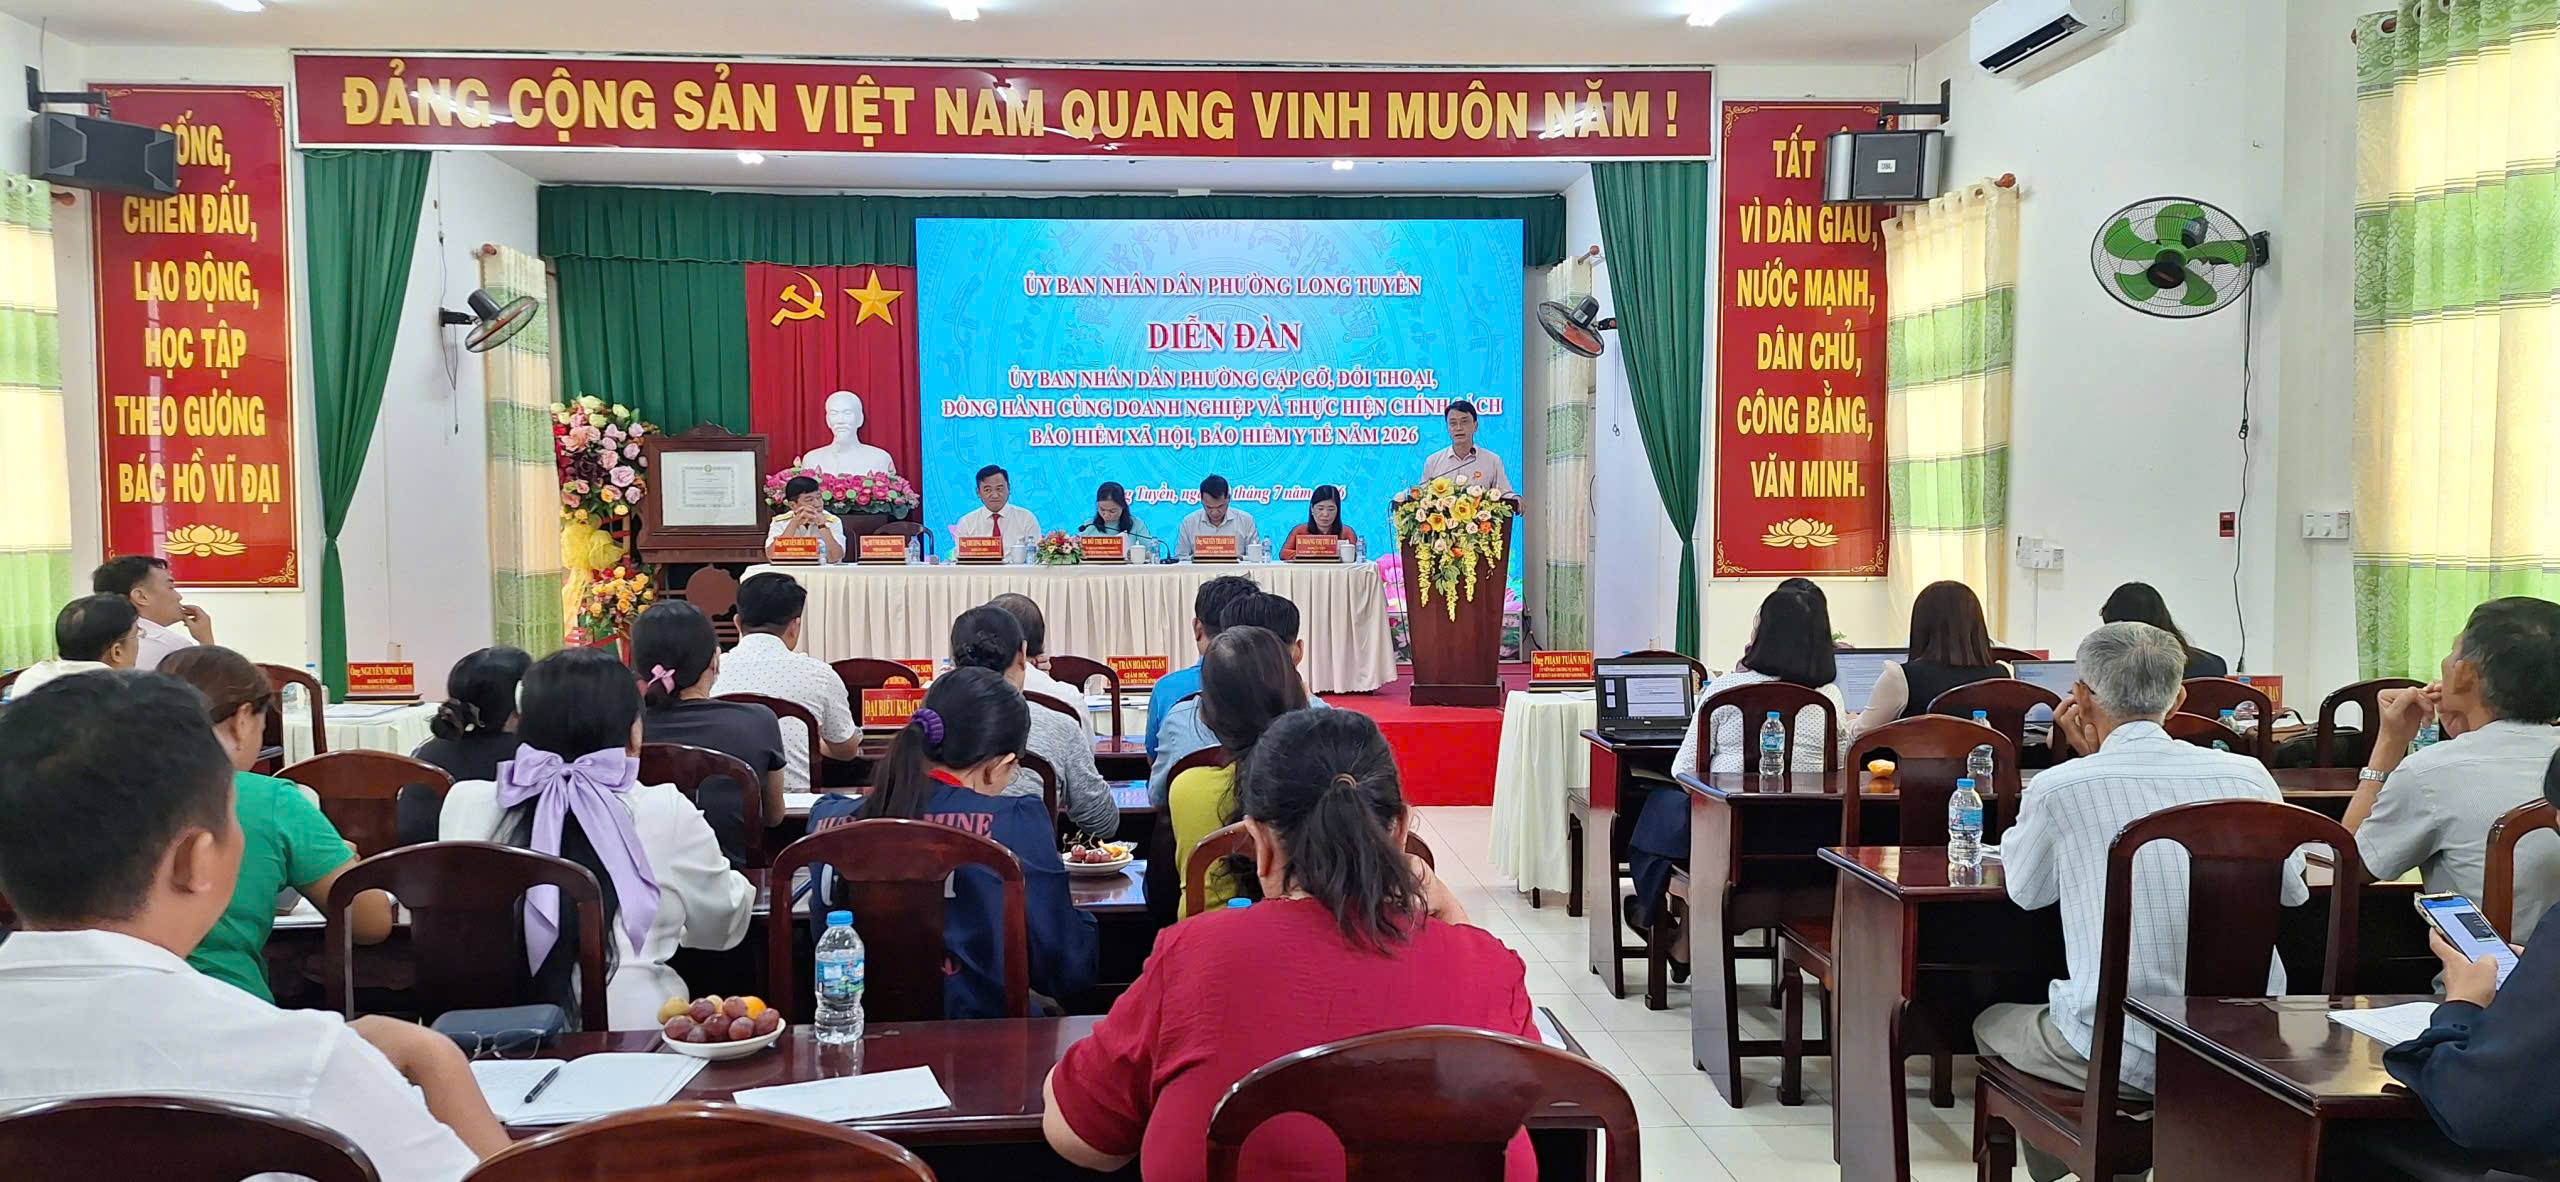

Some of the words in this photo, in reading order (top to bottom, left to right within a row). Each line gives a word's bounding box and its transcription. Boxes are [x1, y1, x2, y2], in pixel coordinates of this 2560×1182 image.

[341, 58, 491, 130] ĐẢNG
[508, 67, 656, 142] CỘNG
[673, 63, 777, 132] SẢN
[795, 74, 916, 147] VIỆT
[934, 88, 1044, 138] NAM
[1060, 89, 1234, 142] QUANG
[1251, 91, 1370, 139] VINH
[1387, 80, 1528, 139] MUÔN
[1543, 79, 1650, 138] NĂM
[160, 109, 231, 174] ỐNG,
[1772, 124, 1816, 179] TẤT
[201, 179, 258, 243] ĐẤU,
[1739, 196, 1761, 243] VÌ
[1766, 197, 1812, 243] DÂN
[134, 260, 180, 302] LAO
[185, 250, 260, 313] ĐỘNG,
[1025, 272, 1055, 294] ỦY
[1057, 277, 1096, 294] BAN
[1102, 272, 1156, 294] NHÂN
[1162, 271, 1202, 294] DÂN
[1208, 272, 1291, 294] PHƯỜNG
[1297, 277, 1351, 294] LONG
[1357, 271, 1421, 294] TUYỀN
[1737, 256, 1798, 308] NƯỚC
[1804, 269, 1876, 316] MẠNH,
[144, 327, 194, 380] HỌC
[200, 318, 248, 379] TẬP
[1148, 316, 1224, 350] DIỄN
[1234, 316, 1302, 350] ĐÀN
[1757, 324, 1804, 370] DÂN
[1809, 318, 1862, 378] CHỦ,
[1008, 366, 1036, 387] ỦY
[1040, 371, 1076, 387] BAN
[1081, 367, 1133, 387] NHÂN
[1137, 367, 1175, 387] DÂN
[1181, 366, 1258, 387] PHƯỜNG
[1263, 369, 1299, 389] GẶP
[1302, 368, 1334, 389] GỠ,
[1338, 365, 1371, 387] ĐỔI
[1375, 369, 1438, 389] THOẠI,
[114, 396, 178, 436] THEO
[183, 392, 266, 437] GƯƠNG
[943, 395, 996, 416] ĐỒNG
[1002, 395, 1052, 416] HÀNH
[1058, 395, 1110, 416] CÙNG
[1115, 399, 1181, 416] DOANH
[1185, 397, 1255, 419] NGHIỆP
[1258, 395, 1282, 415] VÀ
[1286, 397, 1338, 419] THỰC
[1343, 396, 1388, 419] HIỆN
[1391, 394, 1450, 415] CHÍNH
[1736, 387, 1799, 434] CÔNG
[1805, 379, 1873, 441] BẰNG,
[1030, 426, 1069, 446] BẢO
[1074, 425, 1122, 445] HIỂM
[1127, 426, 1152, 445] XÃ
[1157, 427, 1196, 449] HỘI,
[1200, 425, 1237, 445] BẢO
[1242, 425, 1291, 444] HIỂM
[1293, 429, 1308, 444] Y
[1309, 424, 1333, 444] TẾ
[1336, 426, 1379, 444] NĂM
[1383, 427, 1418, 443] 2026
[118, 454, 166, 504] BÁC
[172, 447, 206, 503] HỒ
[210, 453, 237, 503] VĨ
[240, 463, 281, 514] ĐẠI
[1136, 482, 1178, 504] Tuyền,
[1233, 486, 1270, 503] tháng
[1274, 485, 1283, 500] 7
[1284, 487, 1312, 500] năm
[1750, 452, 1796, 498] VĂN
[1801, 460, 1866, 498] MINH.
[864, 698, 878, 720] ĐẠI
[878, 696, 896, 717] BIỂU
